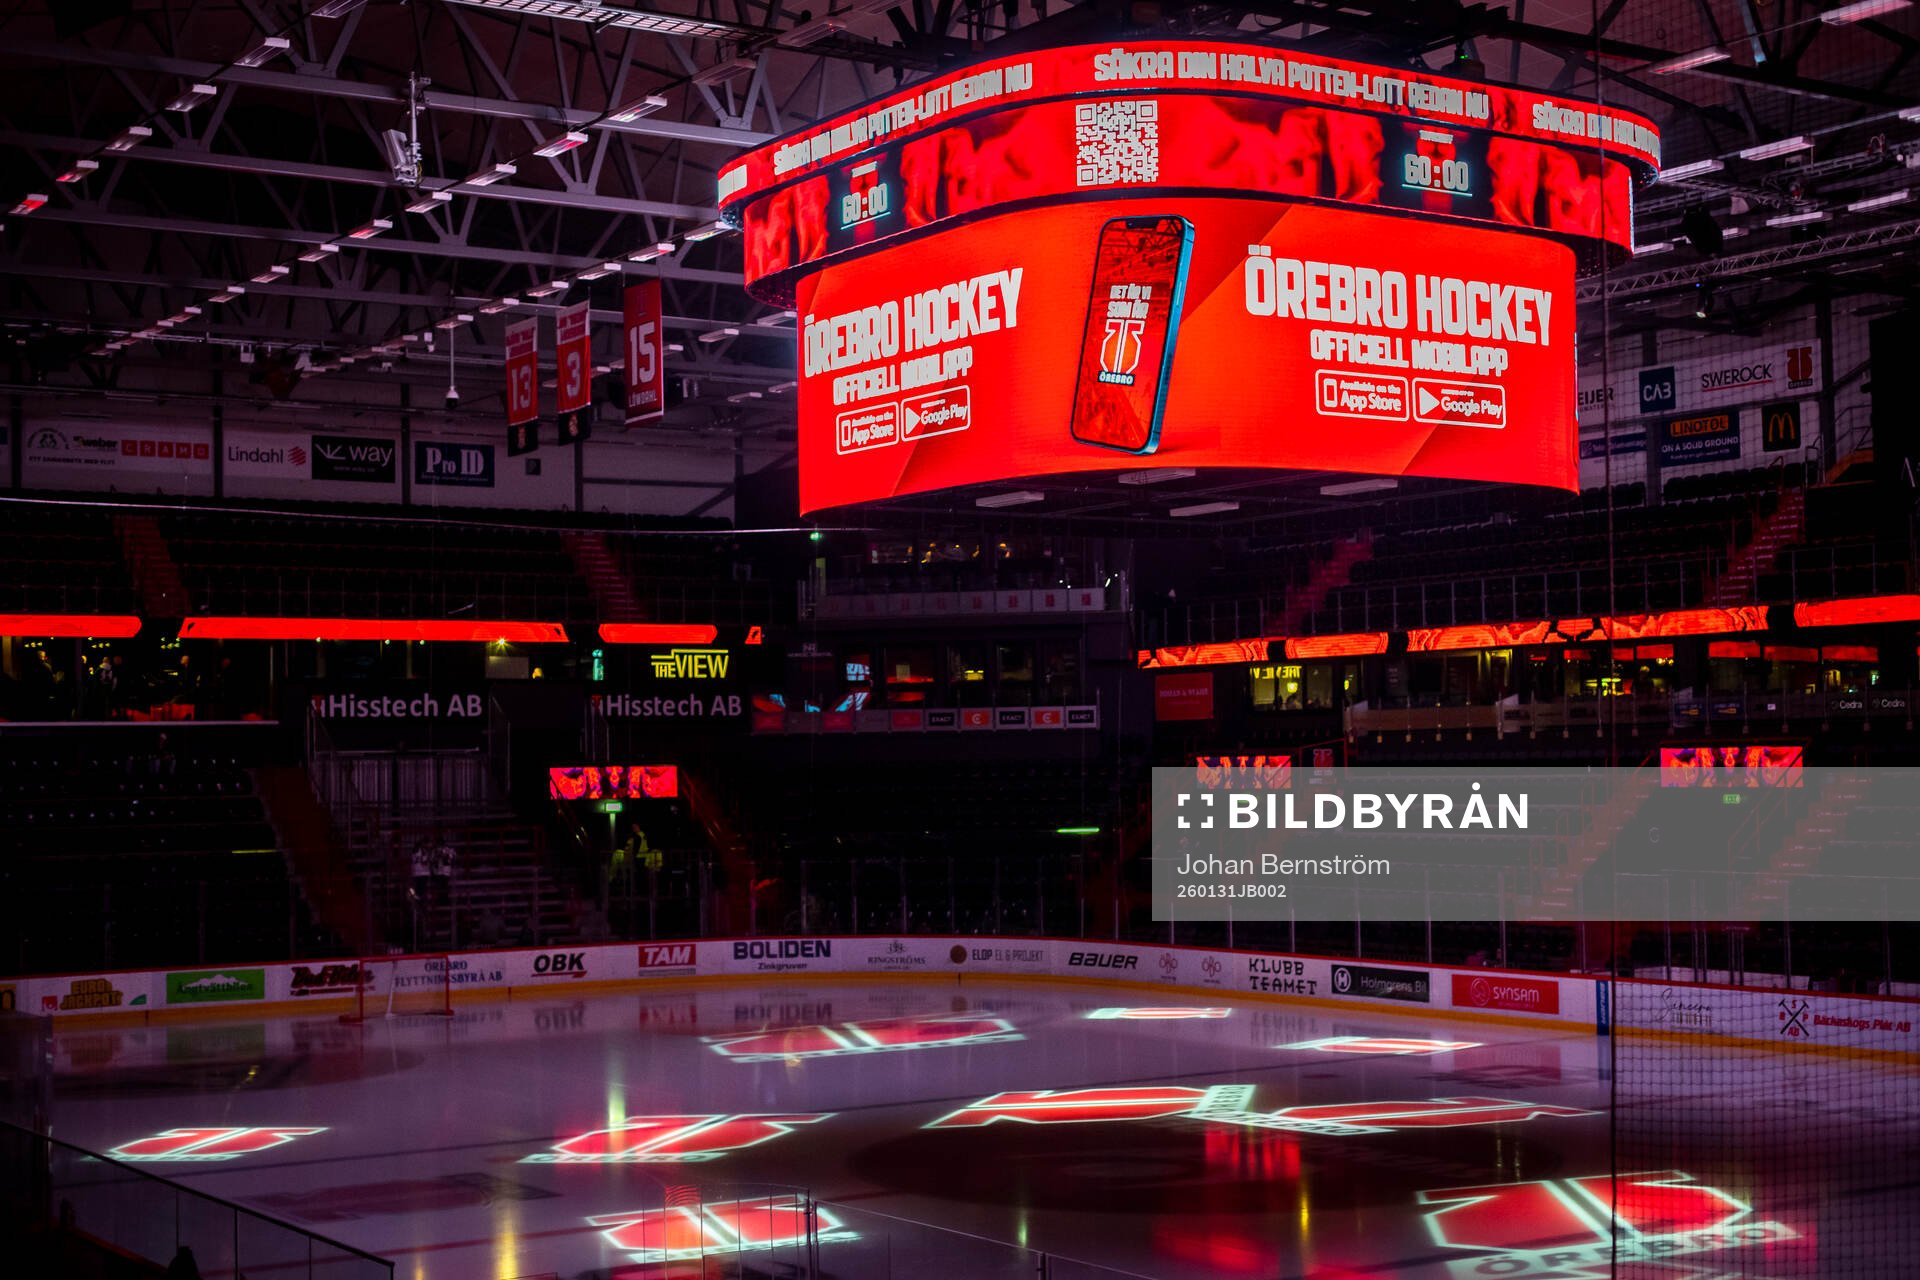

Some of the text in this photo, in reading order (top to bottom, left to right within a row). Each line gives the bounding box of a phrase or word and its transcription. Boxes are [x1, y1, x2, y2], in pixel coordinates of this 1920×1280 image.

[1094, 48, 1489, 120] SÄKRA DIN HALVA POTTEN-LOTT REDAN NU
[1404, 153, 1469, 191] 60:00
[843, 183, 888, 225] 60:00
[1245, 244, 1552, 346] ÖREBRO HOCKEY
[804, 267, 1023, 378] ÖREBRO HOCKEY
[629, 321, 656, 386] 15
[1310, 329, 1508, 377] OFFICIELL MOBILAPP
[566, 351, 581, 398] 3
[900, 345, 973, 391] MOBILAPP
[1099, 371, 1134, 385] ÖREBRO
[1701, 363, 1773, 389] SWEROCK
[511, 364, 532, 411] 13
[1341, 391, 1402, 411] App Store
[1441, 397, 1503, 419] Google Play
[921, 404, 968, 426] Google Play
[852, 424, 894, 445] App Store
[228, 446, 284, 464] Lindahl
[350, 443, 393, 467] way
[651, 655, 728, 678] THE VIEW
[329, 694, 483, 718] Hisstech AB
[606, 694, 741, 717] Hisstech AB
[644, 945, 691, 965] TAM
[733, 940, 832, 960] BOLIDEN
[972, 949, 993, 961] ELOP
[424, 959, 468, 973] ÖRERO
[534, 953, 586, 973] OBK
[1249, 958, 1304, 976] KLUBB
[394, 969, 502, 988] FLYTTNINSBYRÅ AB
[1250, 977, 1317, 995] TEAMET
[1361, 976, 1427, 993] Holmgrens Bil
[1494, 986, 1540, 1003] SYNSAM
